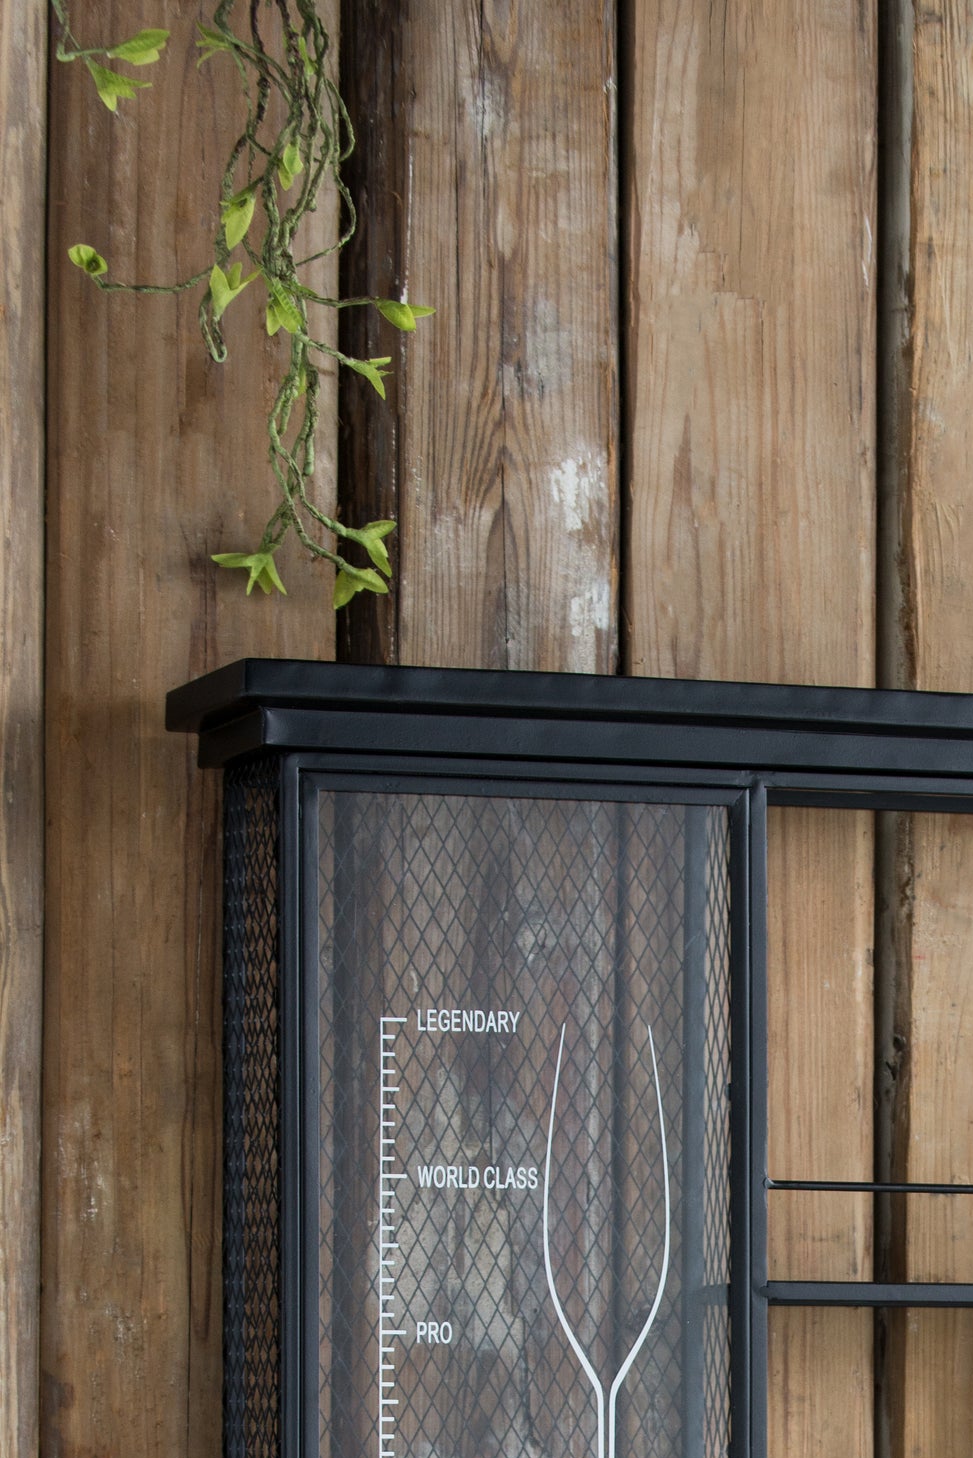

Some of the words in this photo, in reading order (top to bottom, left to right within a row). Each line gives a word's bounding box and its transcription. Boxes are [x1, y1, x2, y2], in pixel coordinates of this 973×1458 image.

[417, 1009, 520, 1033] LEGENDARY
[417, 1165, 480, 1189] WORLD
[483, 1166, 538, 1190] CLASS
[416, 1321, 453, 1344] PRO
